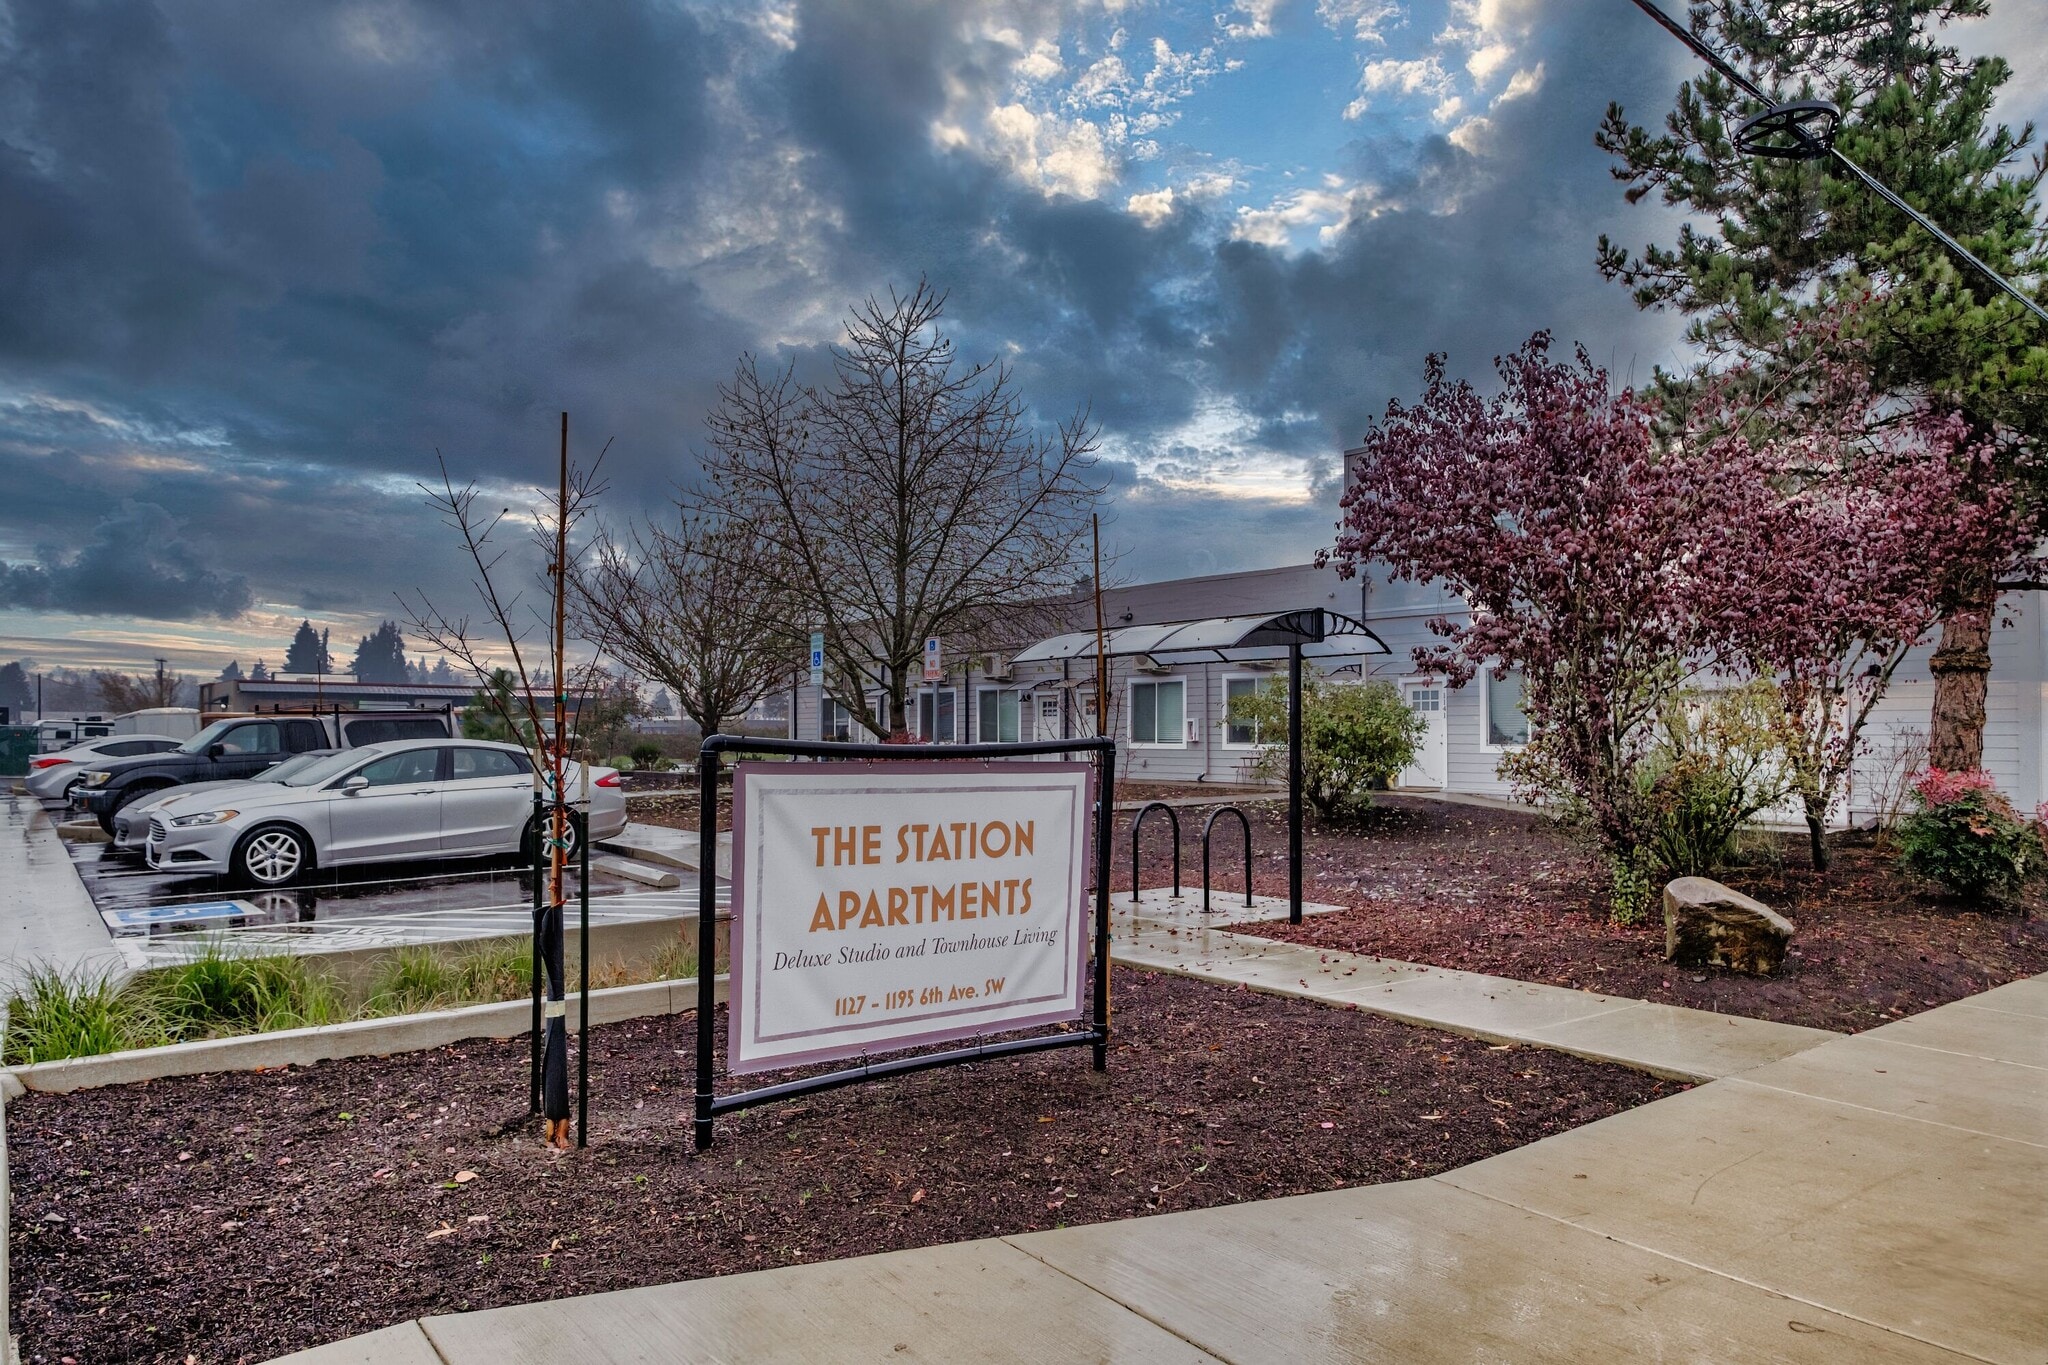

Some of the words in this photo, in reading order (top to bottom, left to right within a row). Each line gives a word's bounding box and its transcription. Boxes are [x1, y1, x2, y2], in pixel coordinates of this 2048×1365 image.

[811, 825, 882, 867] THE
[895, 820, 1035, 864] STATION
[808, 877, 1033, 933] APARTMENTS
[772, 949, 833, 972] Deluxe
[837, 943, 891, 965] Studio
[895, 938, 927, 960] and
[932, 933, 1010, 955] Townhouse
[1013, 926, 1059, 947] Living
[835, 995, 867, 1017] 1127
[885, 989, 915, 1010] 1195
[919, 985, 944, 1006] 6th
[947, 983, 980, 1002] Ave.
[984, 976, 1007, 997] SW
